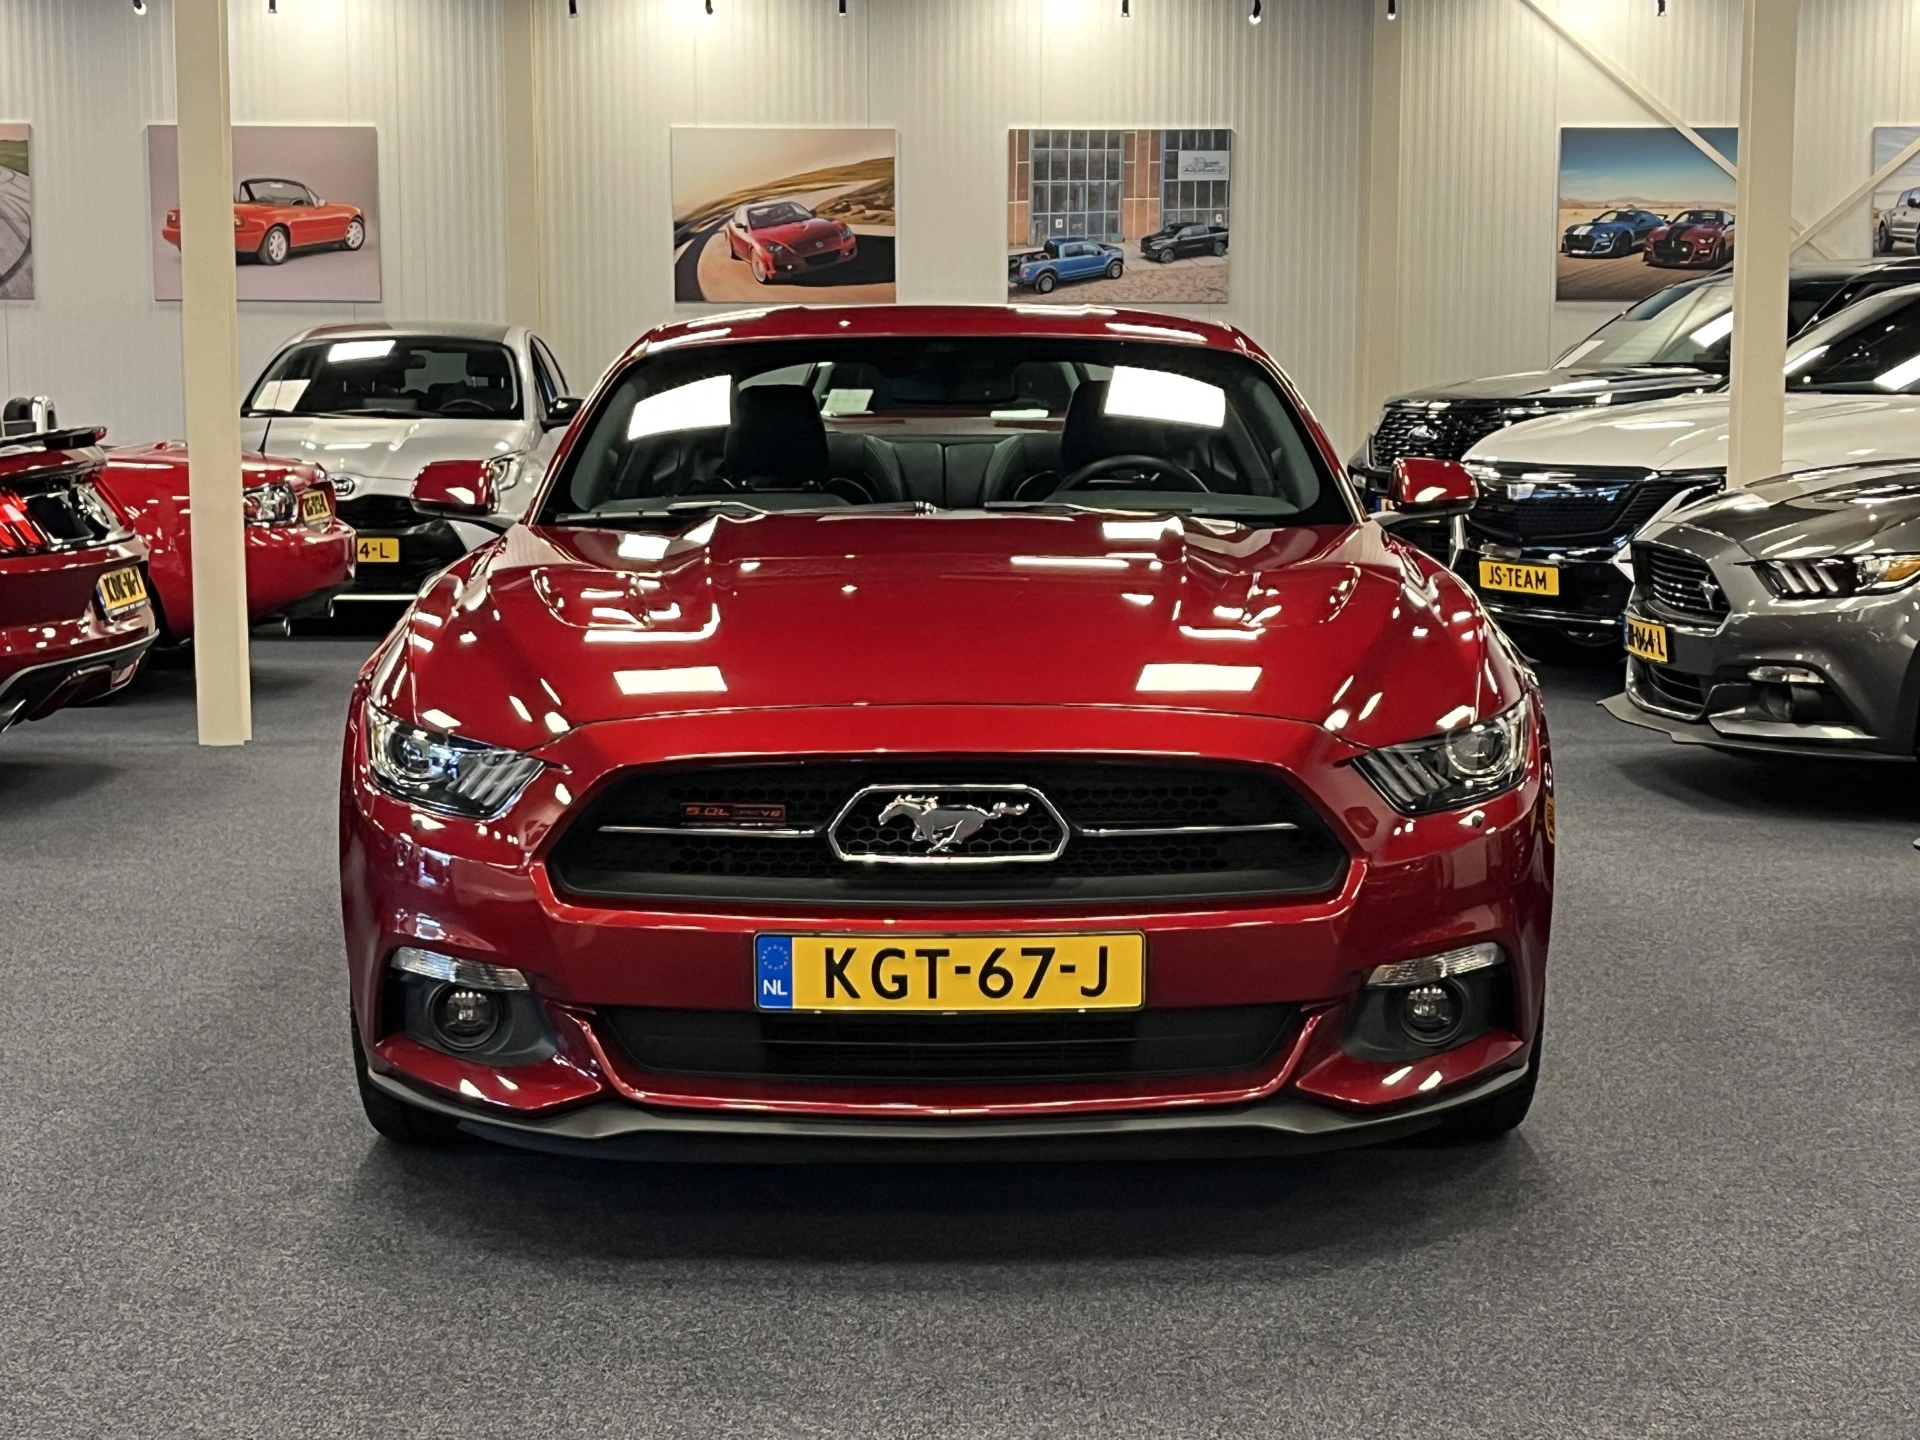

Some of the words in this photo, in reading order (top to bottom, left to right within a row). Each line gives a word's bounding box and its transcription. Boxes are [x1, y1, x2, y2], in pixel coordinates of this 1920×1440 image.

[1488, 565, 1547, 590] JS-TEAM
[825, 945, 1108, 1000] KGT-67-J
[763, 979, 788, 996] NL
